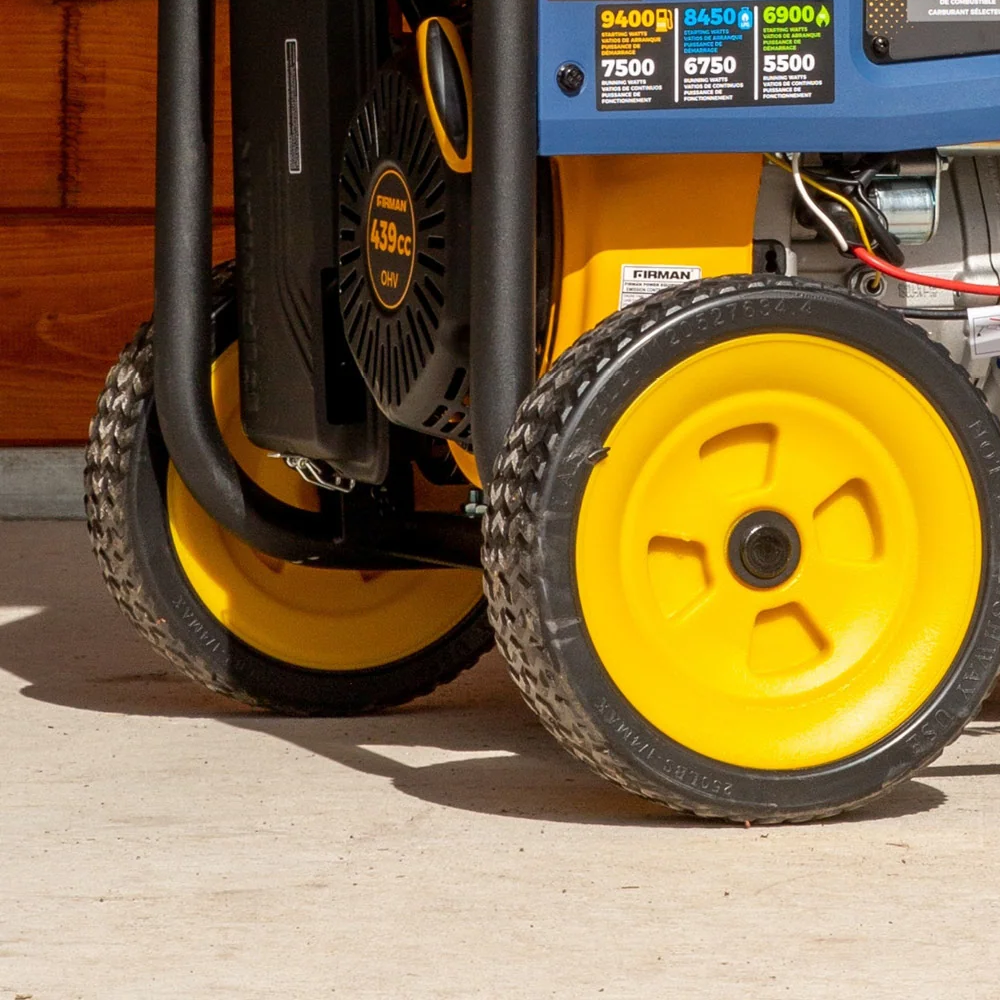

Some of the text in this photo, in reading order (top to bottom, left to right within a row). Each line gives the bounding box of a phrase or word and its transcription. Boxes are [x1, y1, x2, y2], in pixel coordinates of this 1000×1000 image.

[601, 9, 655, 28] 9400
[684, 7, 736, 26] 8450
[763, 5, 815, 24] 6900
[601, 58, 655, 77] 7500
[684, 56, 736, 75] 6750
[763, 53, 815, 72] 5500
[376, 194, 407, 212] FIRMAN
[370, 218, 411, 256] 439cc
[381, 270, 399, 288] OHV
[633, 270, 691, 280] FIRMAN
[906, 709, 955, 751] USE
